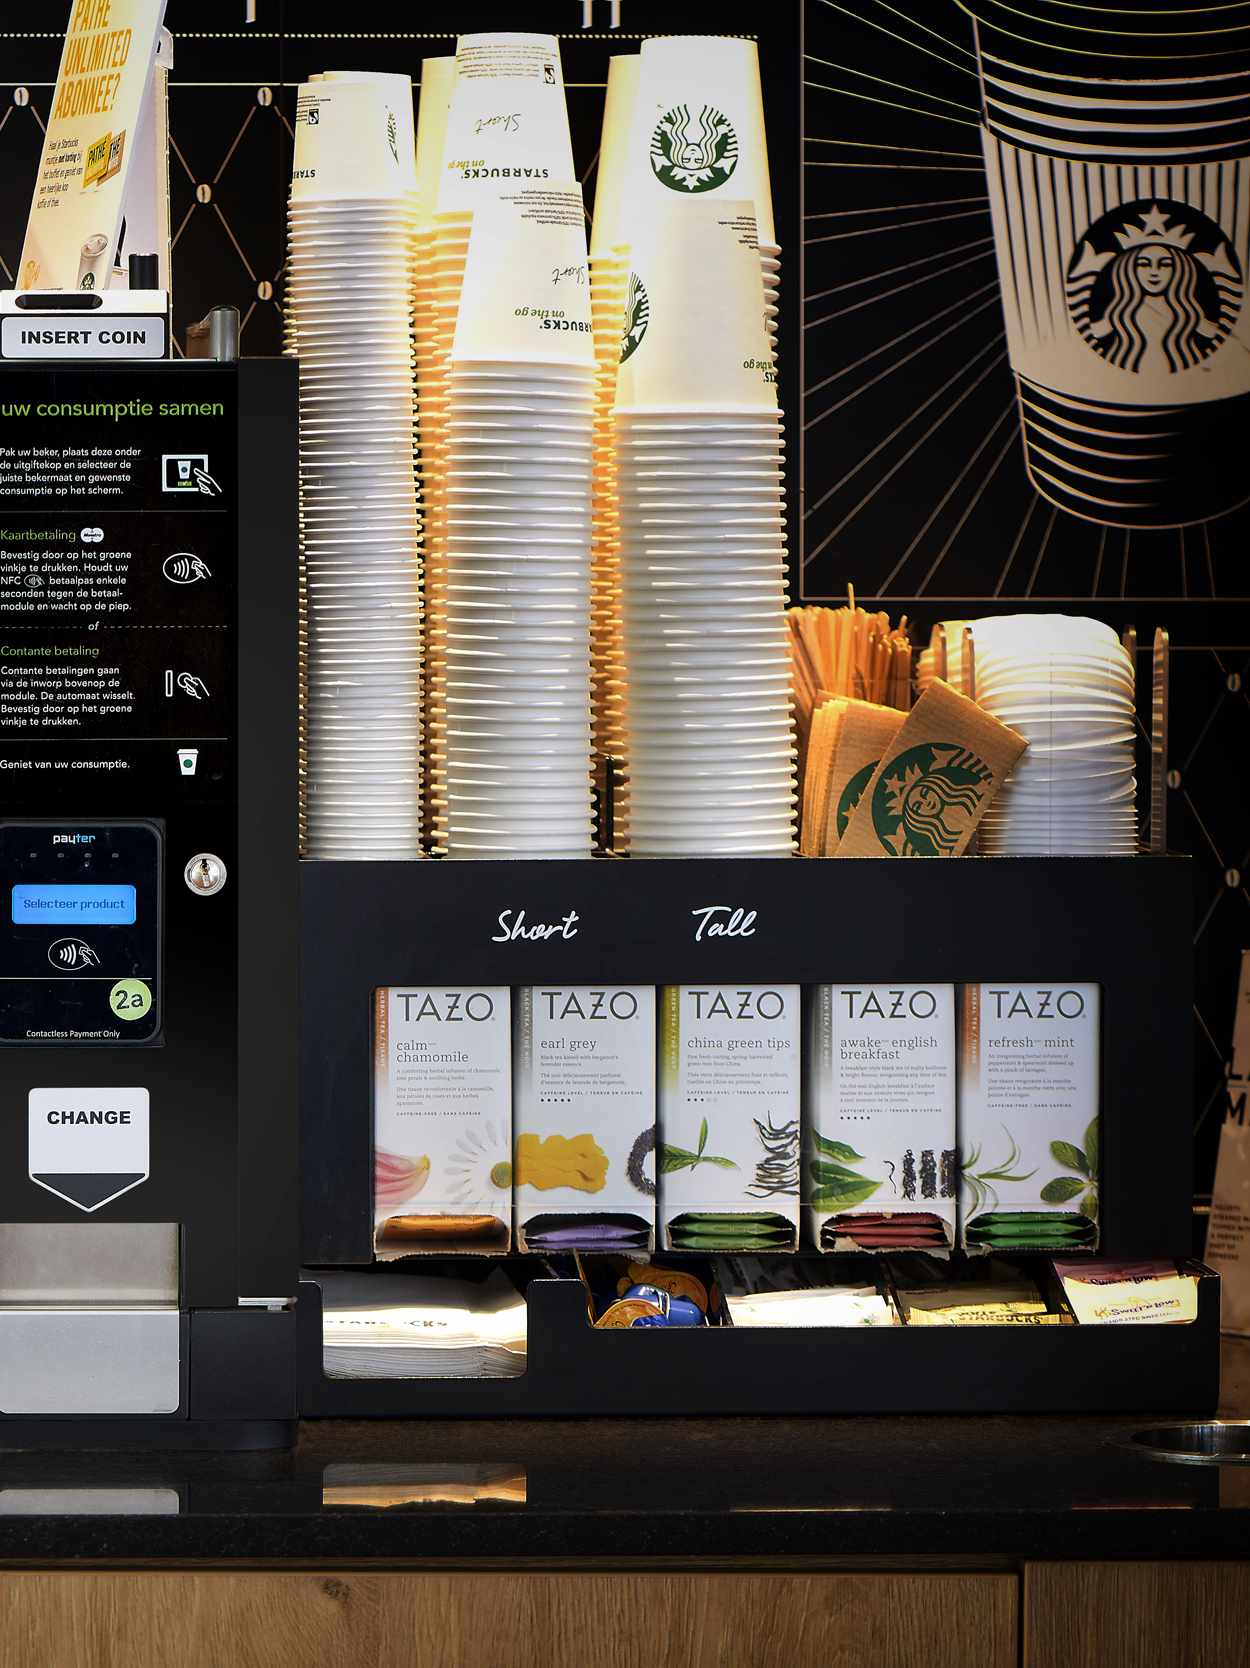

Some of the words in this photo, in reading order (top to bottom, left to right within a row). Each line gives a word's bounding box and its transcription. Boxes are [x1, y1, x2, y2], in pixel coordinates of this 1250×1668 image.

[64, 28, 132, 77] UNLIMITED
[53, 72, 121, 120] ABONNEE?
[474, 113, 522, 135] Short
[464, 168, 549, 179] STARBUCKS
[514, 308, 529, 316] go
[530, 309, 548, 318] the
[549, 310, 565, 318] on
[21, 331, 92, 344] INSERT
[98, 331, 146, 344] COIN
[2, 404, 31, 416] uw
[37, 399, 153, 422] consumptie
[159, 403, 223, 416] samen
[0, 447, 15, 456] Pak
[33, 447, 60, 457] beker,
[62, 447, 89, 458] plaats
[91, 447, 112, 456] deze
[115, 447, 141, 456] onder
[0, 460, 11, 469] de
[14, 460, 62, 471] uitgiftekop
[77, 460, 117, 469] selecteer
[119, 459, 131, 469] de
[0, 473, 23, 484] juiste
[25, 473, 72, 482] bekermaat
[88, 474, 131, 484] gewenste
[0, 486, 53, 496] consumptie
[55, 488, 68, 496] op
[70, 485, 85, 494] het
[88, 485, 123, 494] scherm.
[1, 529, 76, 543] Kaartbetaling
[1, 550, 39, 561] Bevestig
[42, 550, 64, 559] door
[66, 552, 79, 561] op
[82, 550, 97, 559] het
[99, 552, 132, 561] groene
[0, 563, 26, 574] vinkje
[41, 563, 81, 572] drukken.
[84, 562, 113, 572] Houdt
[1, 576, 21, 585] NFC
[49, 576, 94, 586] betaalpas
[96, 575, 126, 584] enkele
[0, 589, 44, 598] seconden
[47, 590, 74, 599] tegen
[76, 588, 88, 597] de
[91, 588, 123, 597] betaal-
[1, 601, 34, 611] module
[50, 601, 77, 610] wacht
[80, 604, 92, 612] op
[94, 601, 106, 610] de
[109, 601, 131, 612] piep.
[88, 621, 99, 630] of
[1, 646, 51, 656] Contante
[54, 645, 99, 658] betaling
[0, 759, 32, 769] Geniet
[71, 759, 130, 770] consumptie.
[53, 833, 96, 845] payter
[24, 899, 78, 908] Selecteer
[80, 899, 125, 911] product
[492, 910, 579, 942] Short
[692, 906, 757, 941] Tall
[114, 989, 144, 1010] 2a
[70, 1030, 102, 1038] Payment
[103, 1030, 120, 1038] Only
[396, 1039, 428, 1051] calm
[540, 1037, 568, 1050] earl
[569, 1039, 597, 1051] grey
[687, 1036, 724, 1049] china
[726, 1038, 765, 1051] green
[767, 1036, 791, 1051] tips
[839, 1037, 882, 1049] awake
[891, 1036, 939, 1051] english
[987, 1036, 1034, 1049] refresh
[1043, 1036, 1075, 1049] mint
[396, 1051, 470, 1063] chamomile
[839, 1048, 901, 1061] breakfast
[47, 1111, 131, 1125] CHANGE
